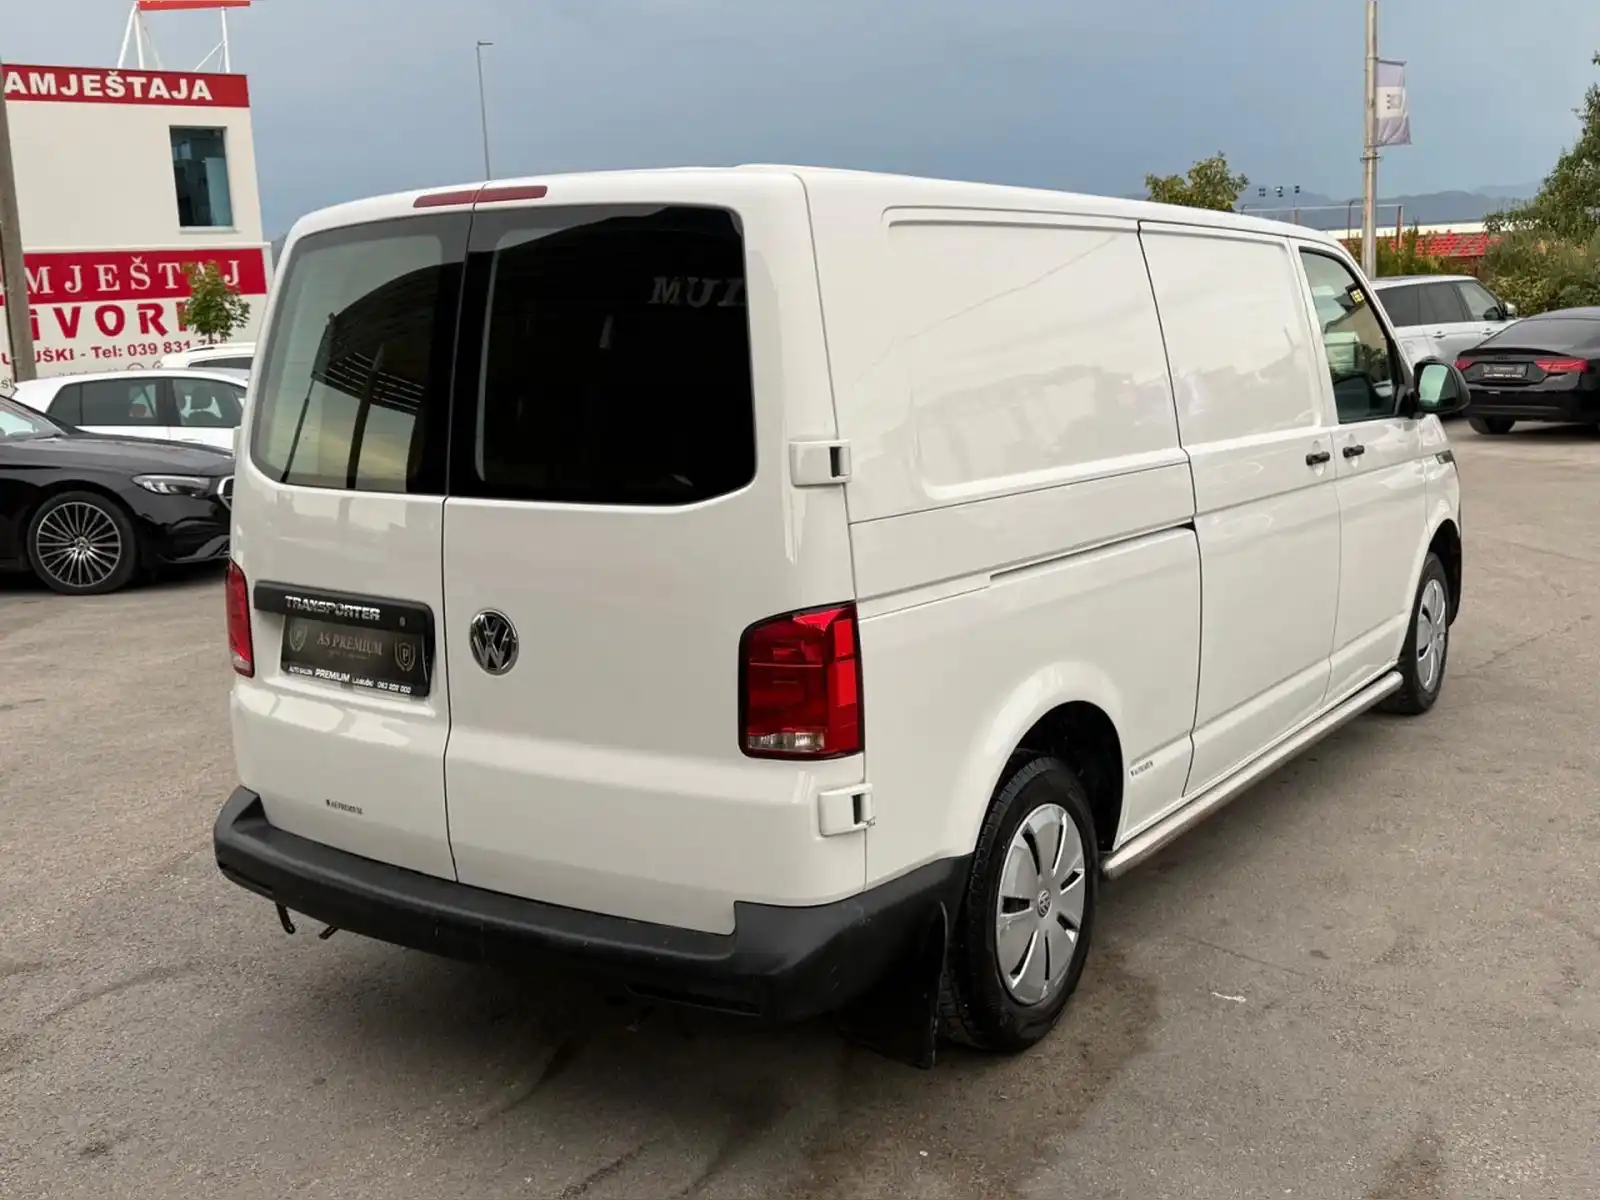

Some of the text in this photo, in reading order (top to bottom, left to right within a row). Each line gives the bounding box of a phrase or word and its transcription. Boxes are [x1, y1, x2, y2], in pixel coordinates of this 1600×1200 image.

[4, 70, 213, 100] AMJEŠTAJA
[91, 345, 122, 360] Tel:
[127, 342, 158, 357] 039
[163, 339, 190, 354] 831
[285, 595, 381, 620] TRANSPORTER
[332, 633, 383, 655] PREMIUM
[315, 668, 350, 682] PREMIUM
